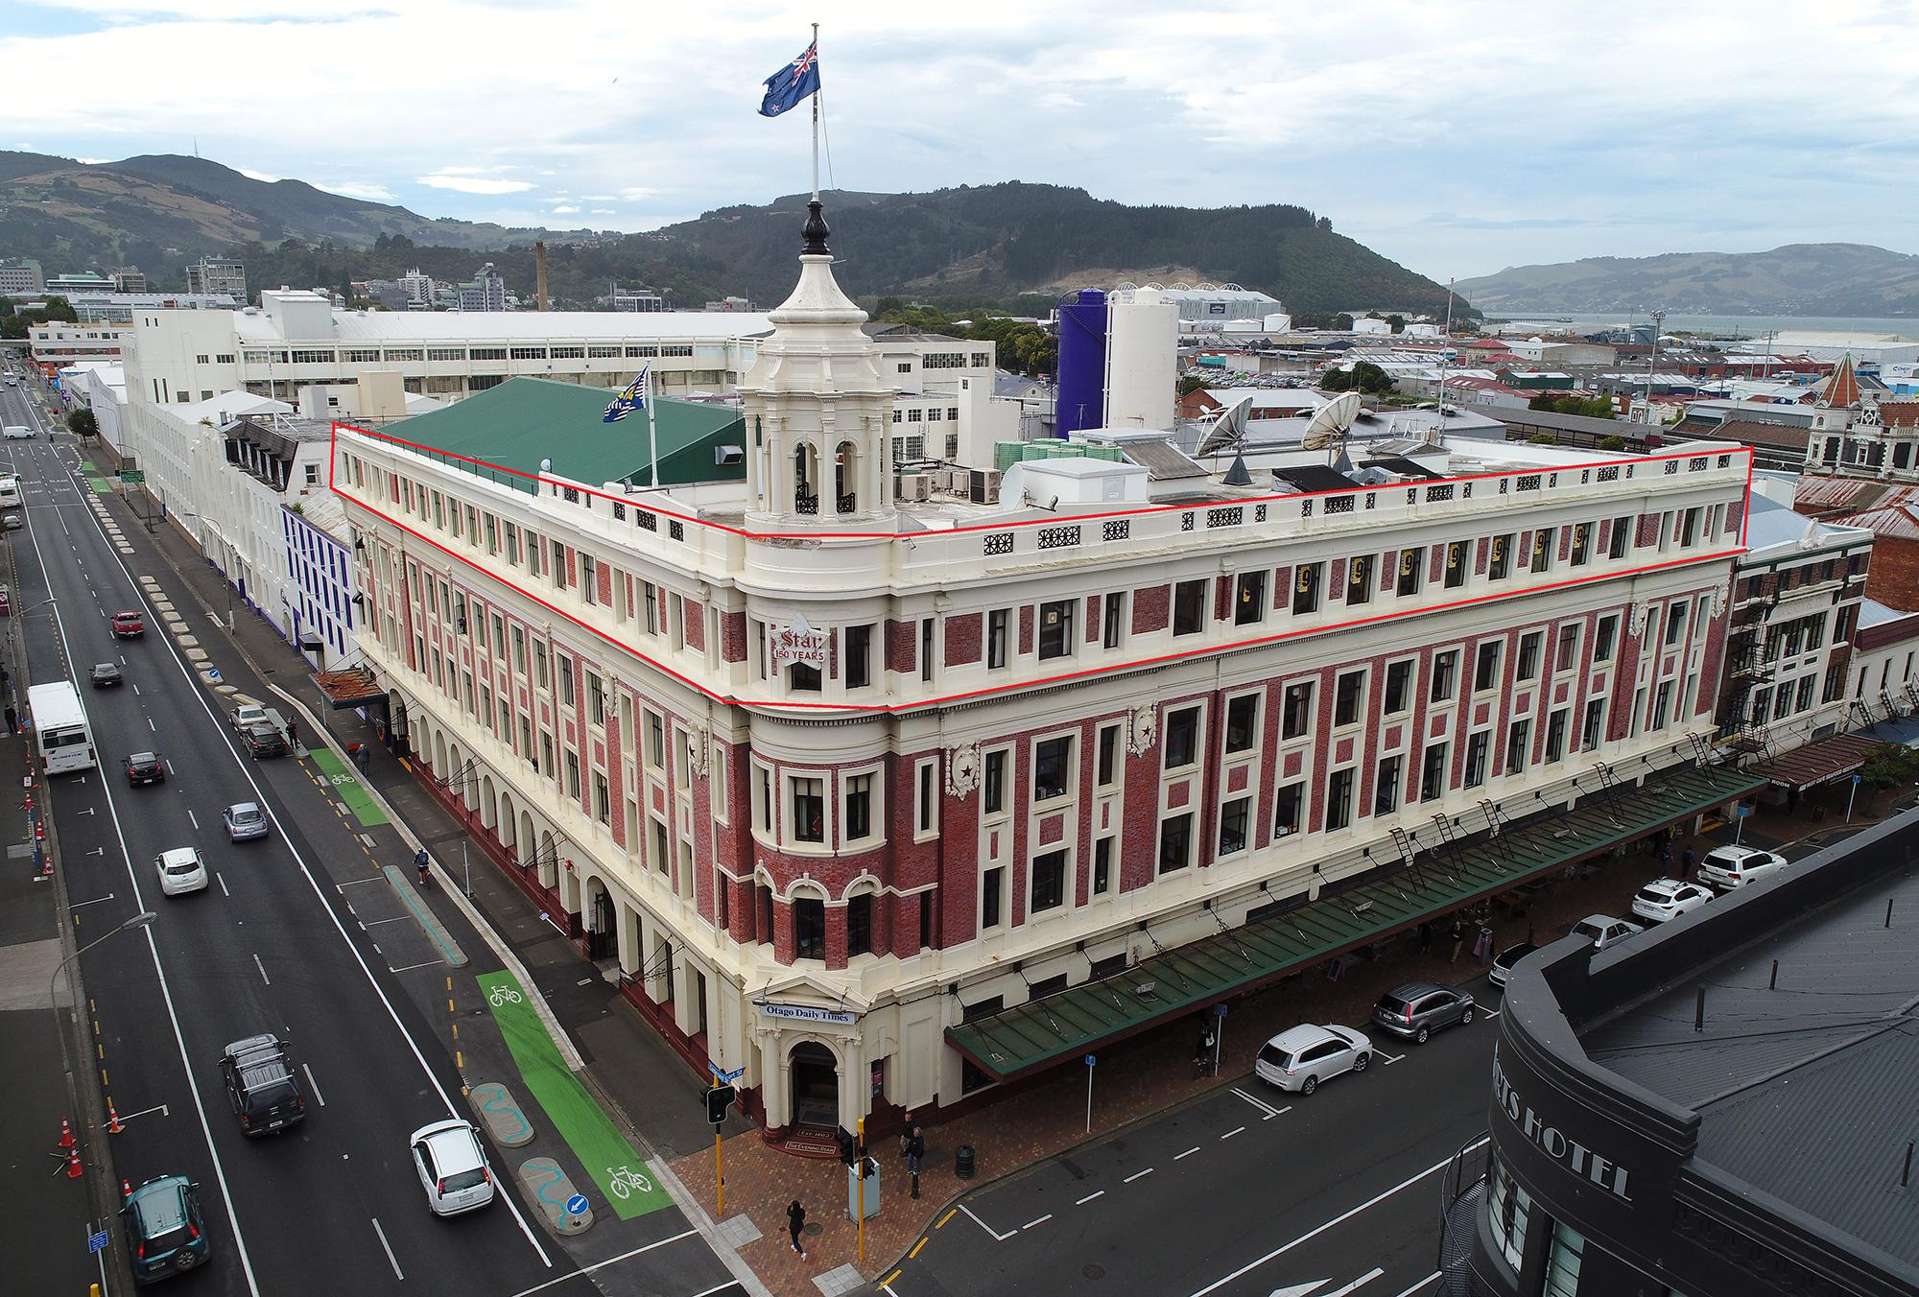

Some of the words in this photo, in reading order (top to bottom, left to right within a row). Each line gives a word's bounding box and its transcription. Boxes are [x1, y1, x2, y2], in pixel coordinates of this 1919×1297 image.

[781, 629, 822, 650] Star
[792, 651, 824, 661] YEARS
[766, 1006, 794, 1017] Otago
[796, 1009, 819, 1020] Daily
[821, 1012, 849, 1022] Times
[1524, 1106, 1632, 1202] HOTEL
